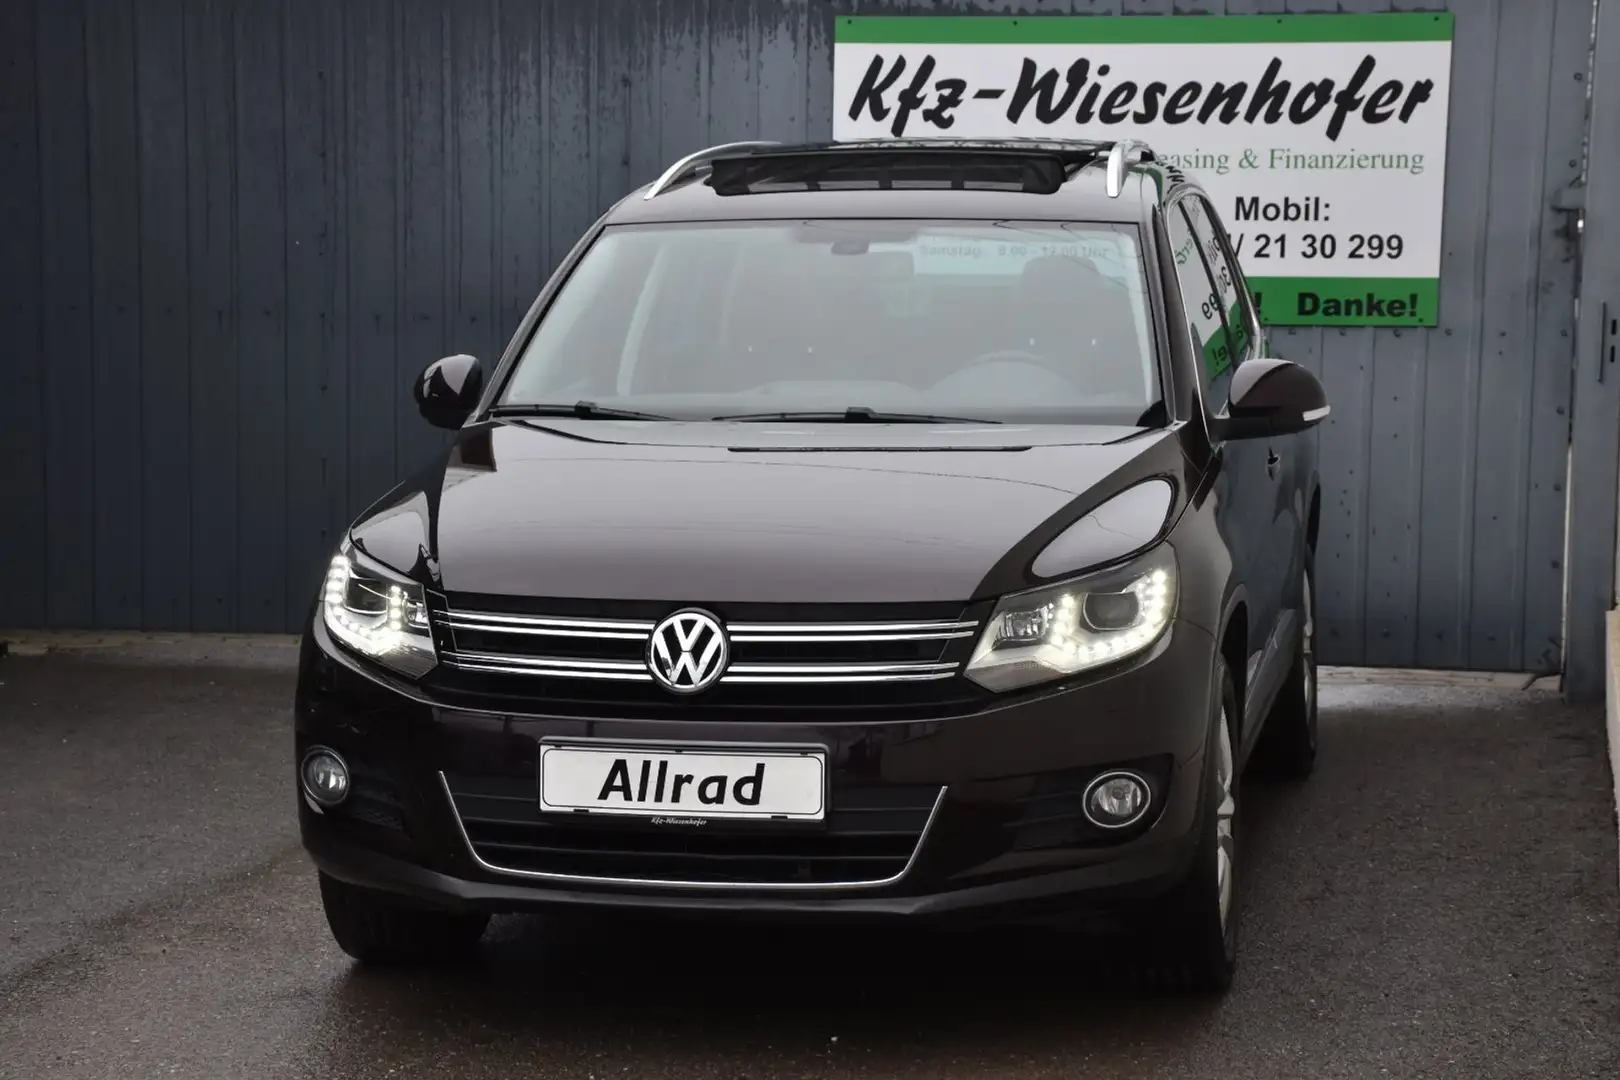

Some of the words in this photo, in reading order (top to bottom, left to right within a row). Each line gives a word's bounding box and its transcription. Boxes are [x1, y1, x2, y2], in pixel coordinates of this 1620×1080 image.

[848, 54, 1434, 141] Kfz-Wiesenhofer
[1157, 148, 1231, 176] easing
[1238, 149, 1260, 169] &
[1268, 148, 1425, 175] Finanzierung
[1235, 196, 1330, 221] Mobil:
[1254, 233, 1286, 258] 21
[1301, 233, 1336, 259] 30
[1348, 234, 1403, 259] 299
[1297, 292, 1418, 317] Danke!
[597, 758, 766, 806] Allrad
